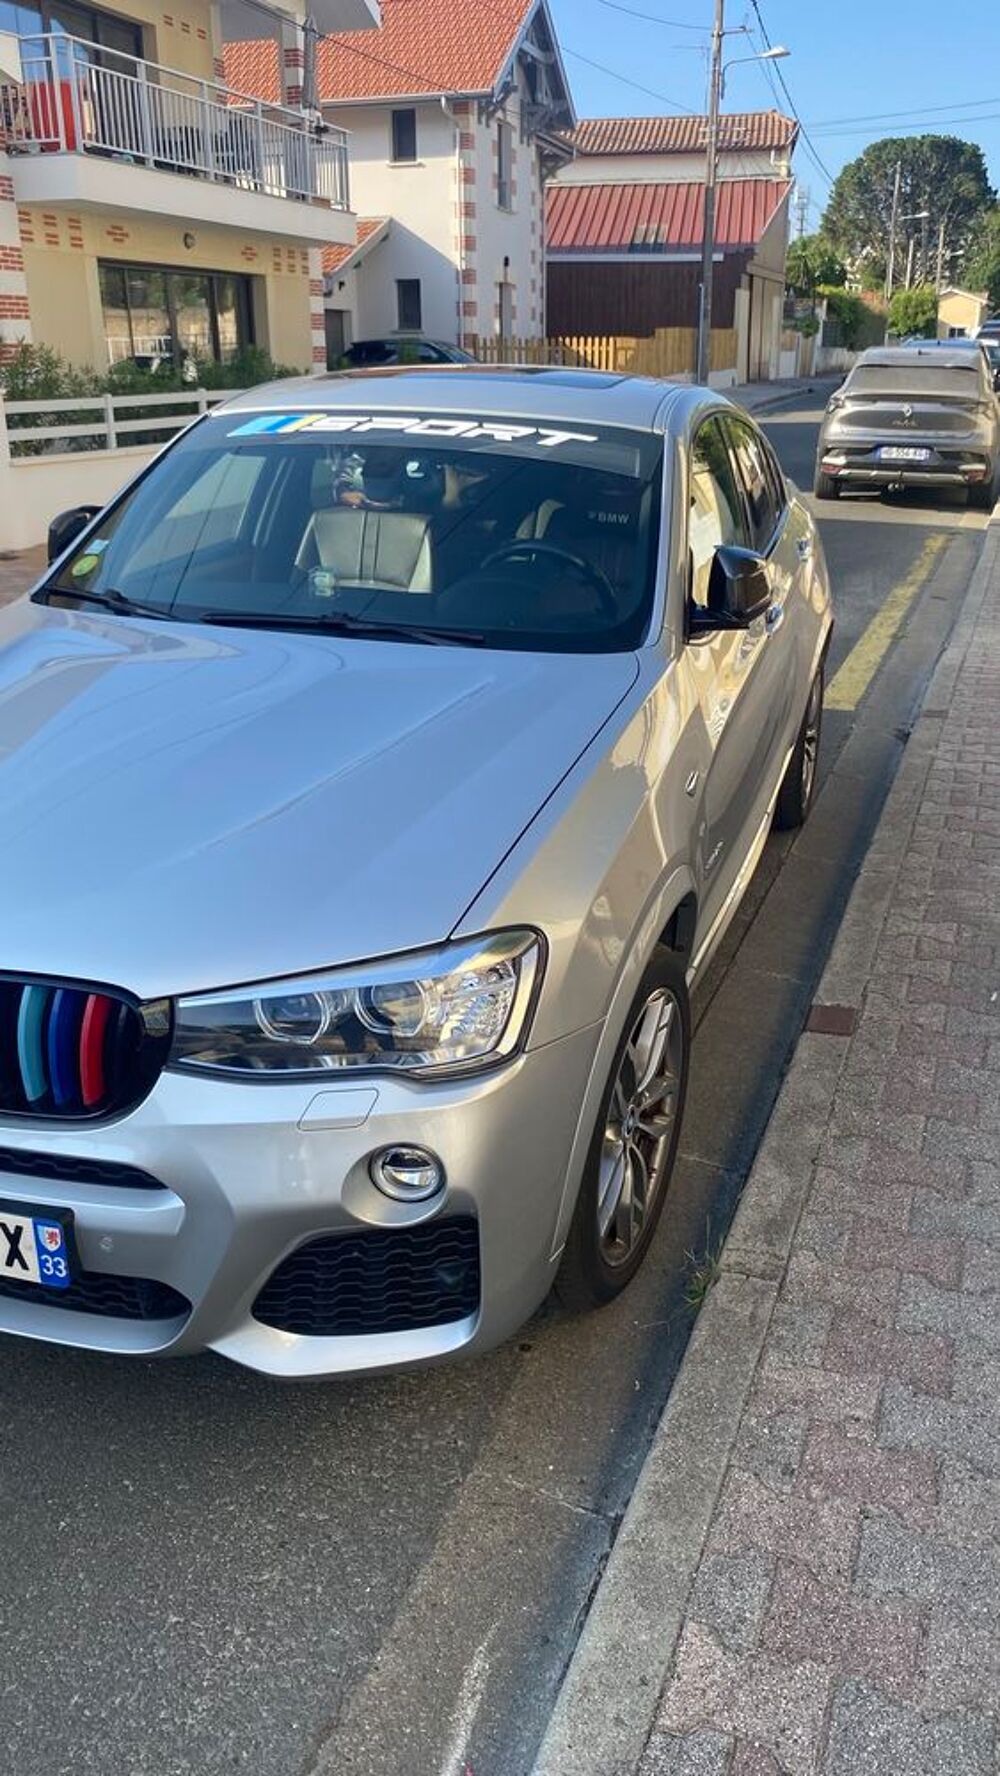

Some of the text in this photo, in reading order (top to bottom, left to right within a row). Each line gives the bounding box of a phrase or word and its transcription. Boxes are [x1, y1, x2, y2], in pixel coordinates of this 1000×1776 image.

[297, 415, 599, 447] SPORT
[597, 511, 630, 524] BMW
[0, 1222, 30, 1271] X
[41, 1254, 67, 1278] 33
